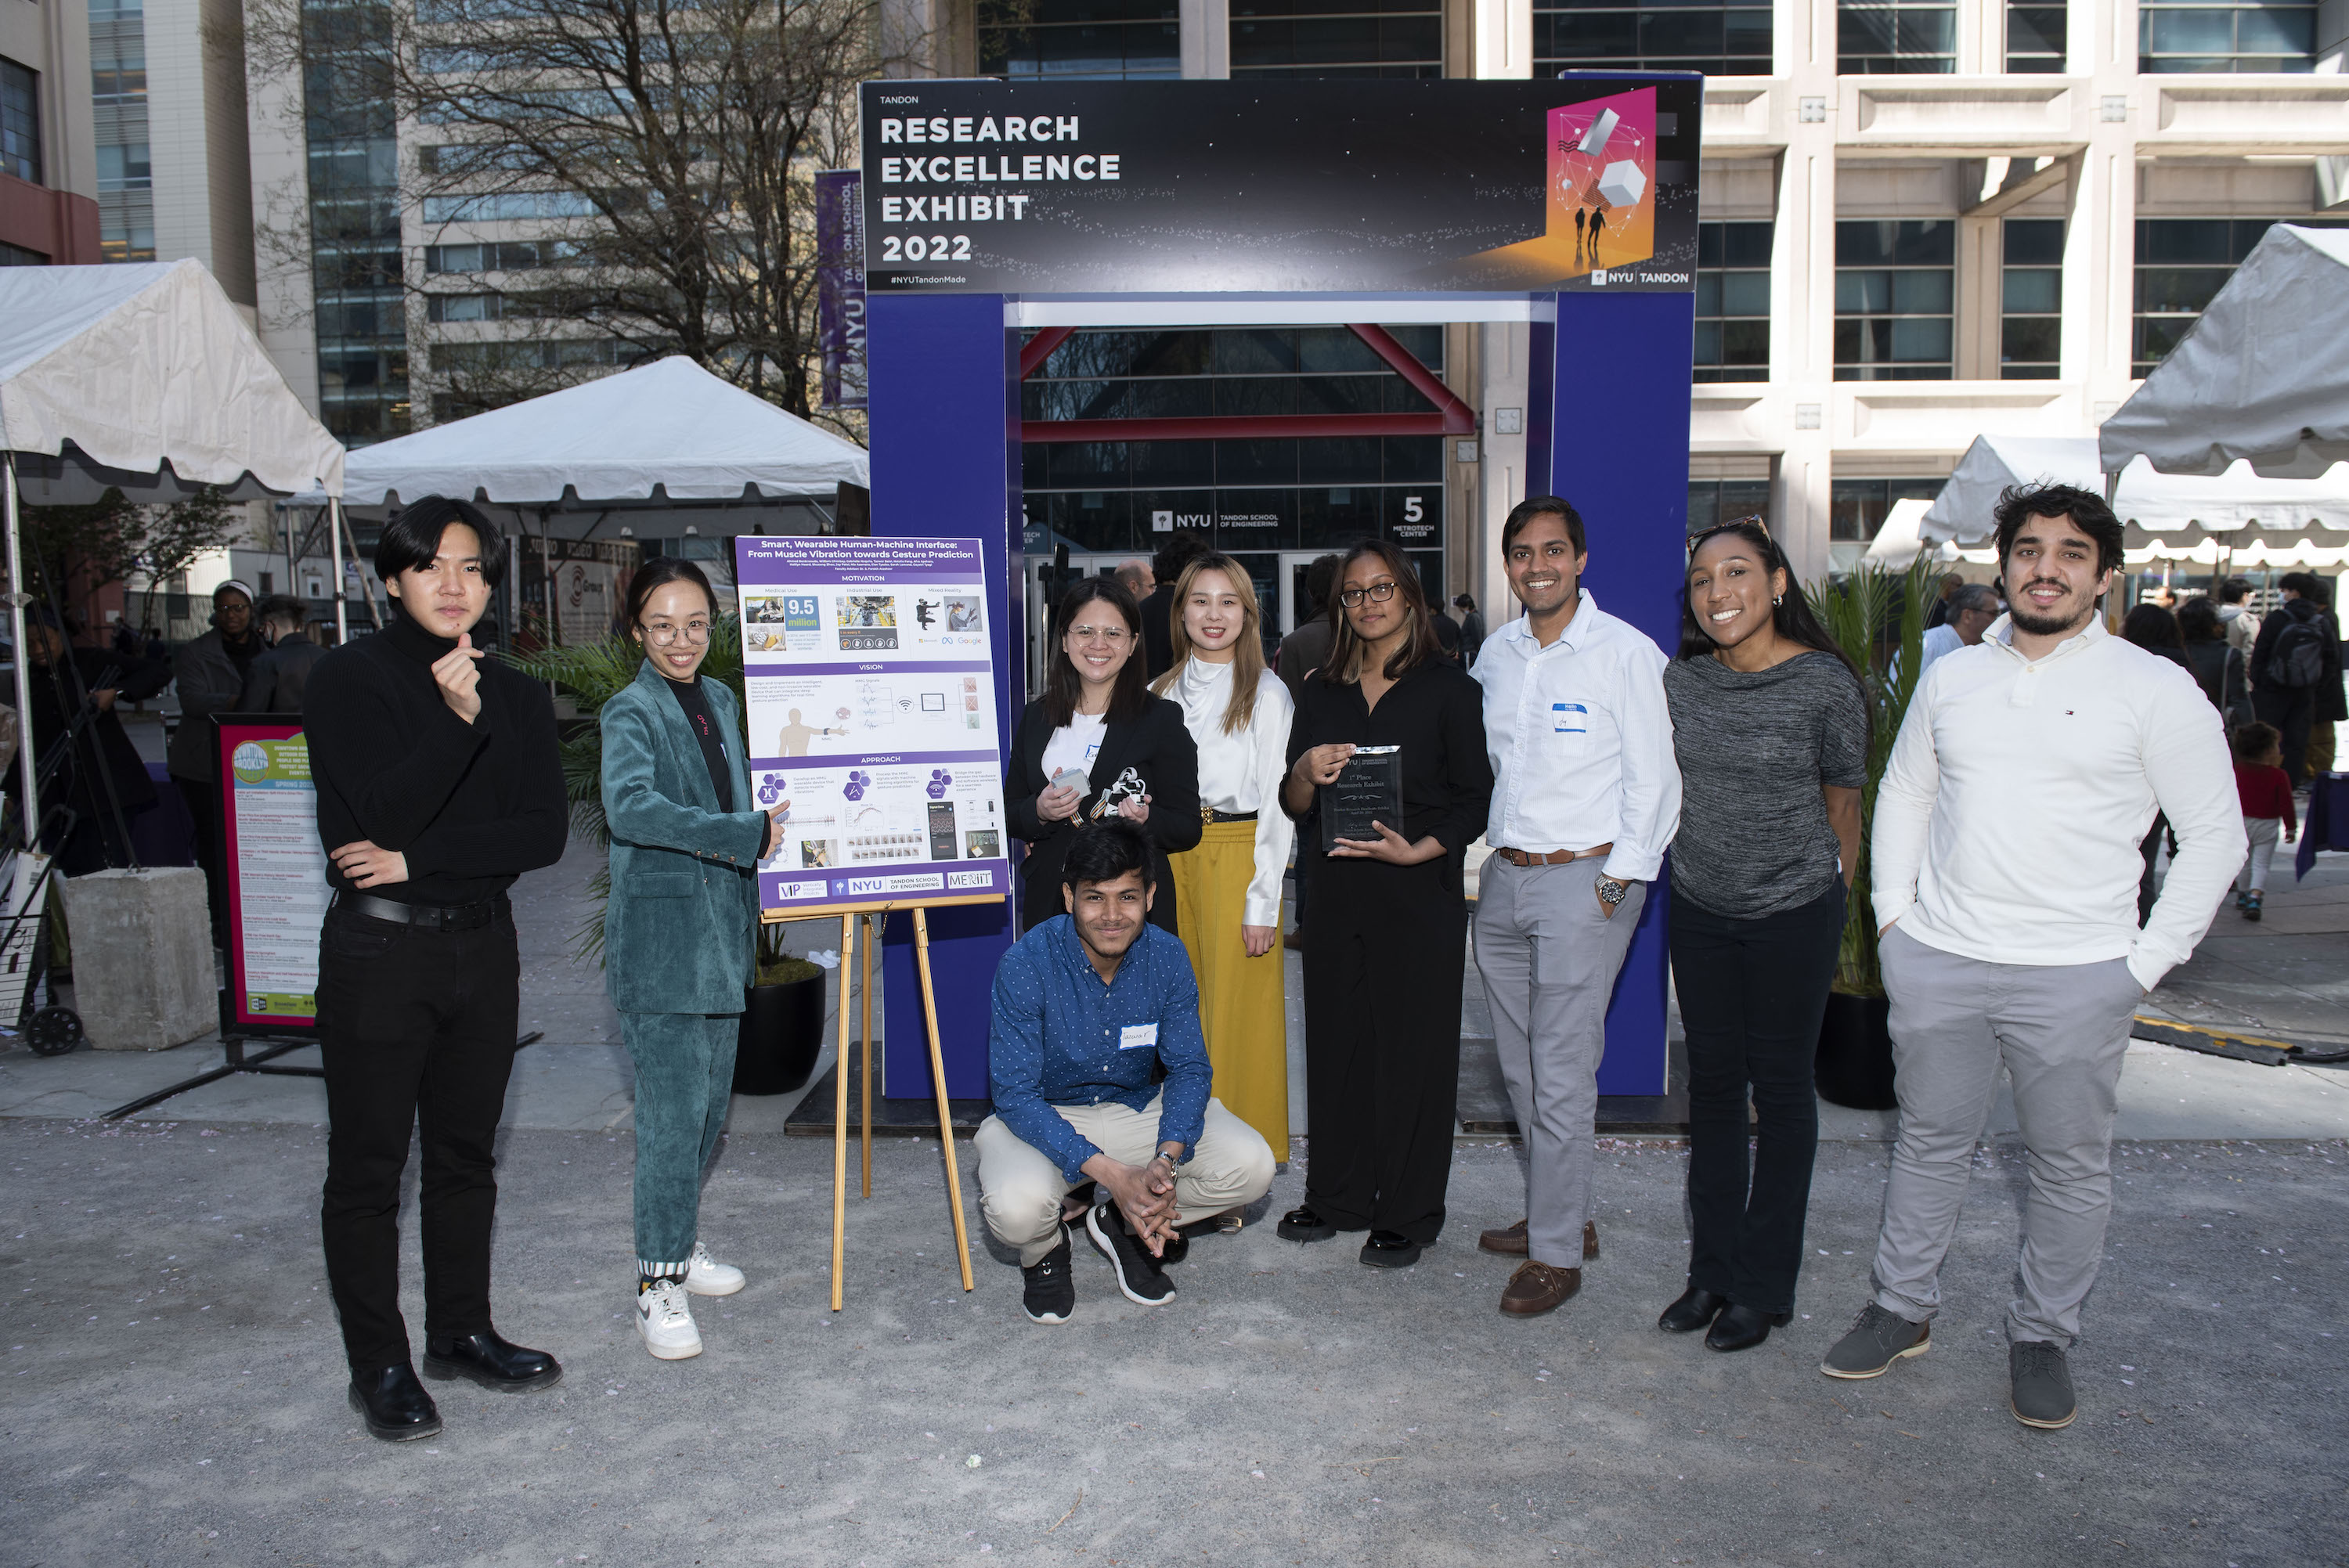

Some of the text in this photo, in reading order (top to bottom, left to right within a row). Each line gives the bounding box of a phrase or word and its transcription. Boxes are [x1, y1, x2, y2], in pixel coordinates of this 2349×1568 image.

[880, 96, 918, 104] TANDON
[882, 116, 1079, 143] RESEARCH
[882, 155, 1120, 182] EXCELLENCE
[882, 195, 1029, 222] EXHIBIT
[843, 182, 853, 283] TAON SCHOOL
[882, 235, 972, 261] 2022
[891, 276, 966, 285] #NYUTandonMade
[1609, 273, 1689, 283] NYU TANDON
[1405, 497, 1423, 523] 5
[1177, 514, 1211, 528] NYU
[583, 579, 604, 595] Group
[788, 600, 814, 615] 9.5
[781, 884, 800, 897] VIP
[853, 880, 882, 892] NYU
[1122, 1030, 1150, 1040] Tazwar
